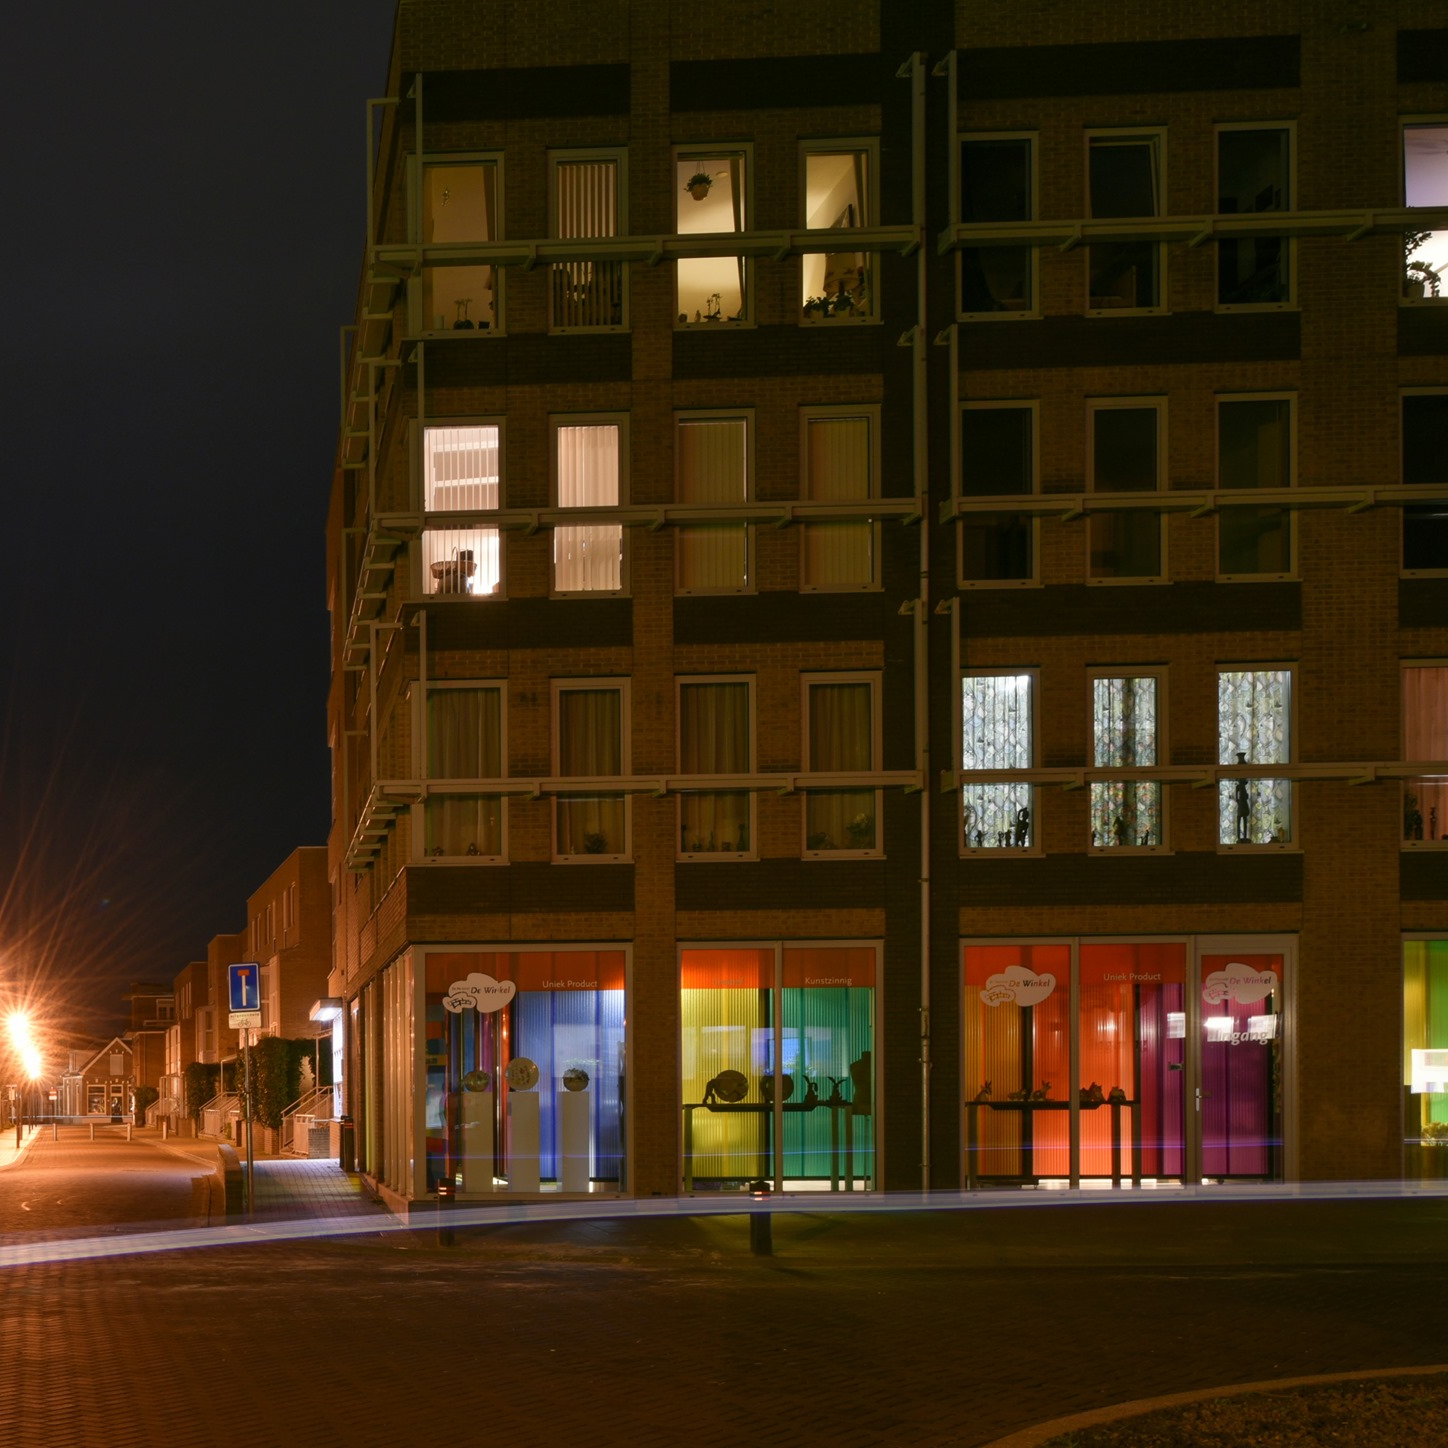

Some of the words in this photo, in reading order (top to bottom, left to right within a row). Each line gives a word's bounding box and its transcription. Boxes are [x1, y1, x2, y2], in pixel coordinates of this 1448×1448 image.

[1103, 973, 1127, 981] Uniek
[1129, 972, 1161, 981] Product
[1229, 977, 1241, 985] De
[1243, 976, 1272, 985] Winkel
[542, 980, 565, 988] Uniek
[567, 979, 598, 988] Product
[805, 977, 852, 987] Kunstzinnig
[1008, 980, 1021, 988] De
[1022, 979, 1051, 988] Winkel
[470, 986, 481, 994] De
